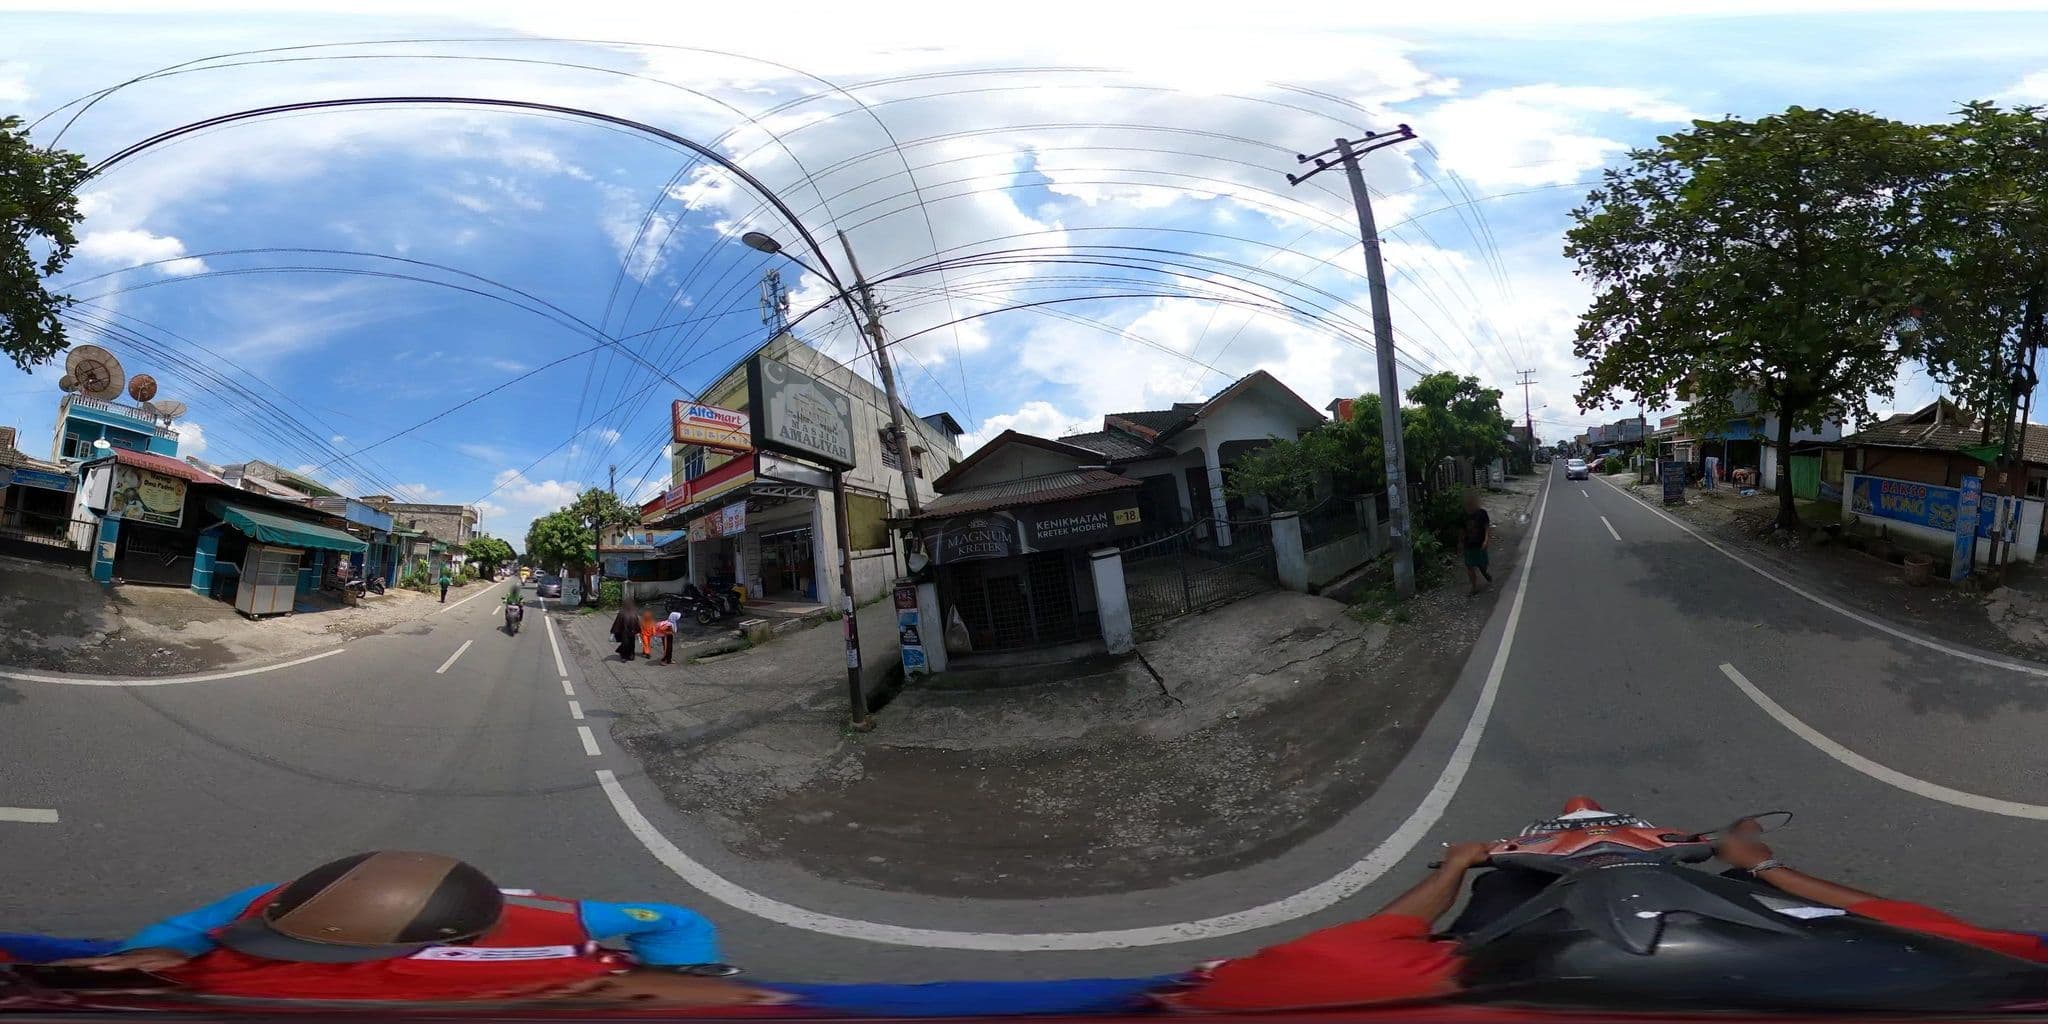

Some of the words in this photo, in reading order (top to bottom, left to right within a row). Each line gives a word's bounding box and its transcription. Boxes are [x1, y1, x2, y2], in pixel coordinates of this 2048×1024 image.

[688, 405, 742, 425] Alfamart
[791, 418, 838, 444] MASJID
[780, 425, 848, 459] AMALIYAH
[1882, 480, 1927, 499] BAKSO
[1036, 511, 1107, 531] KENIKMATAN
[1123, 510, 1136, 521] 18
[947, 530, 1012, 549] MAGNUM
[1037, 528, 1069, 539] KRETEK
[1071, 521, 1108, 534] MODERN
[958, 541, 1002, 555] KRETEK
